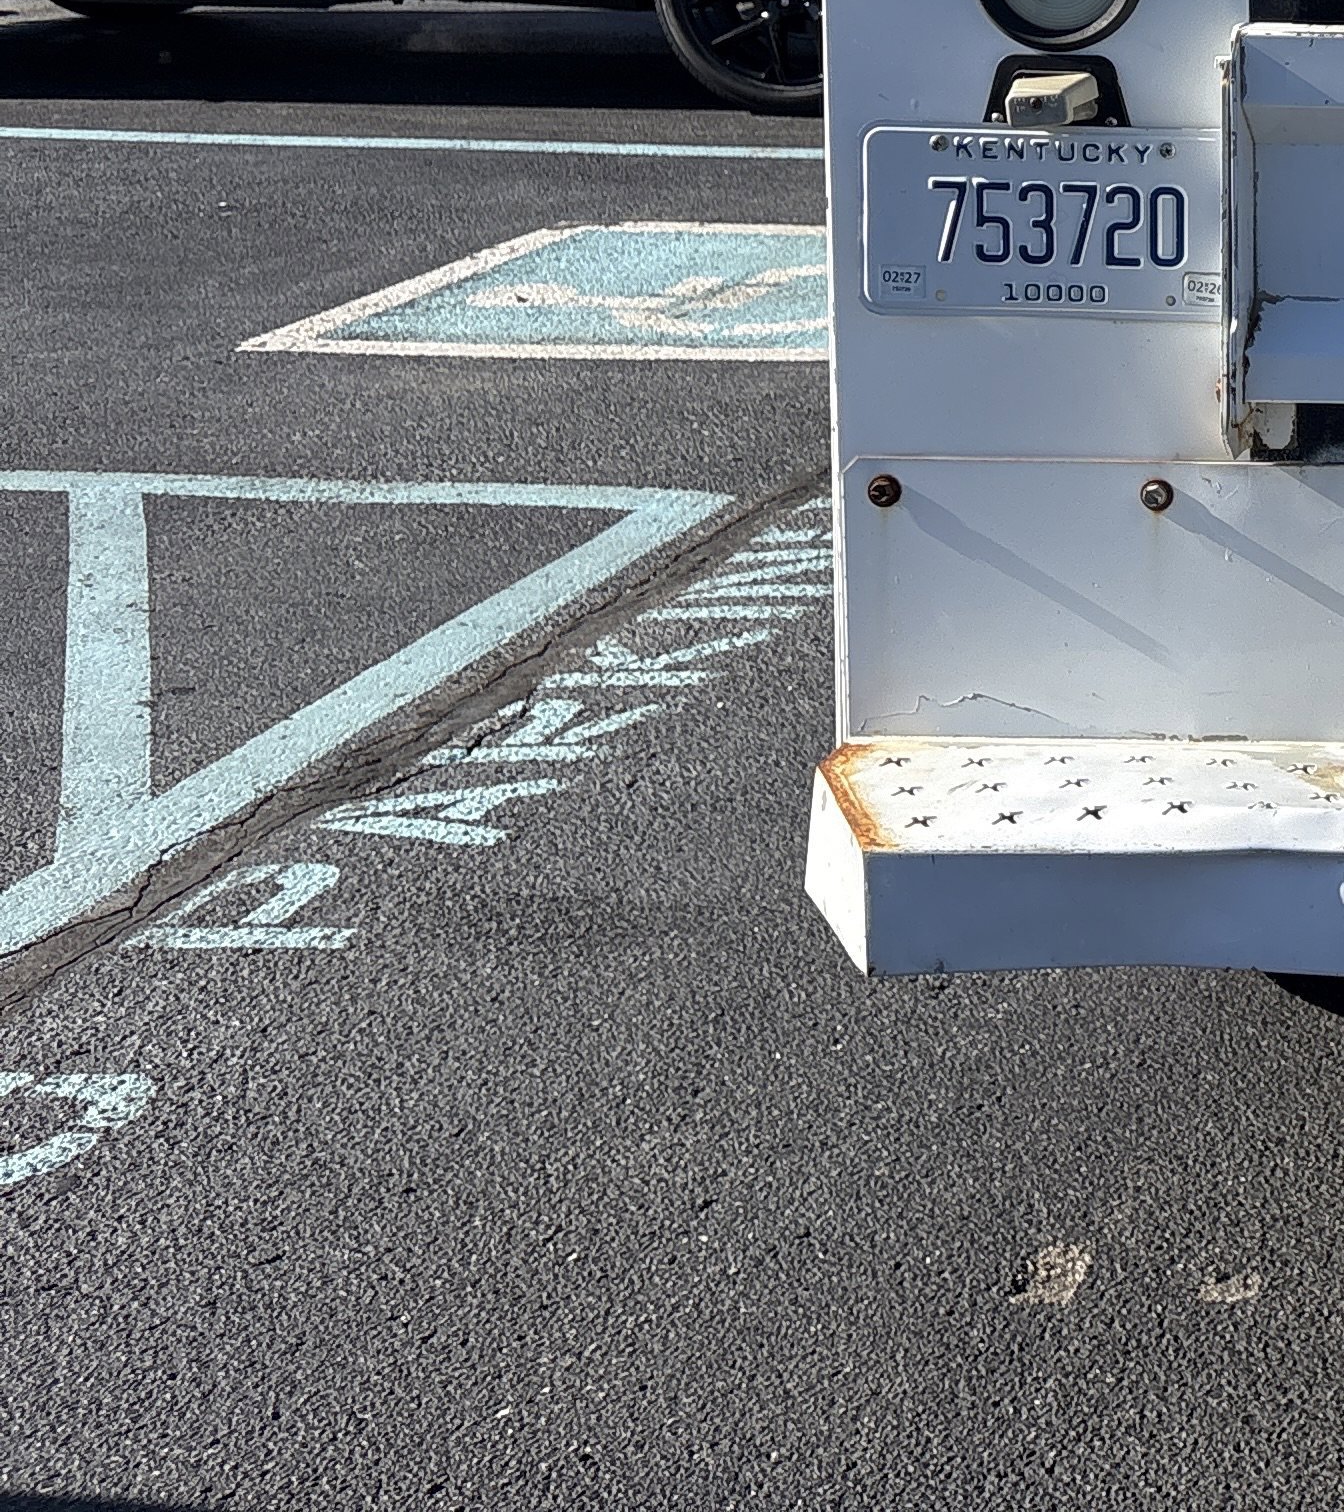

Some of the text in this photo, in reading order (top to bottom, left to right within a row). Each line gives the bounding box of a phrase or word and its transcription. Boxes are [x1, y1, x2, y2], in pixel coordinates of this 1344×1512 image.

[954, 138, 1152, 164] KENTUCKY
[929, 179, 1187, 269] 753720
[1003, 283, 1109, 303] 10000
